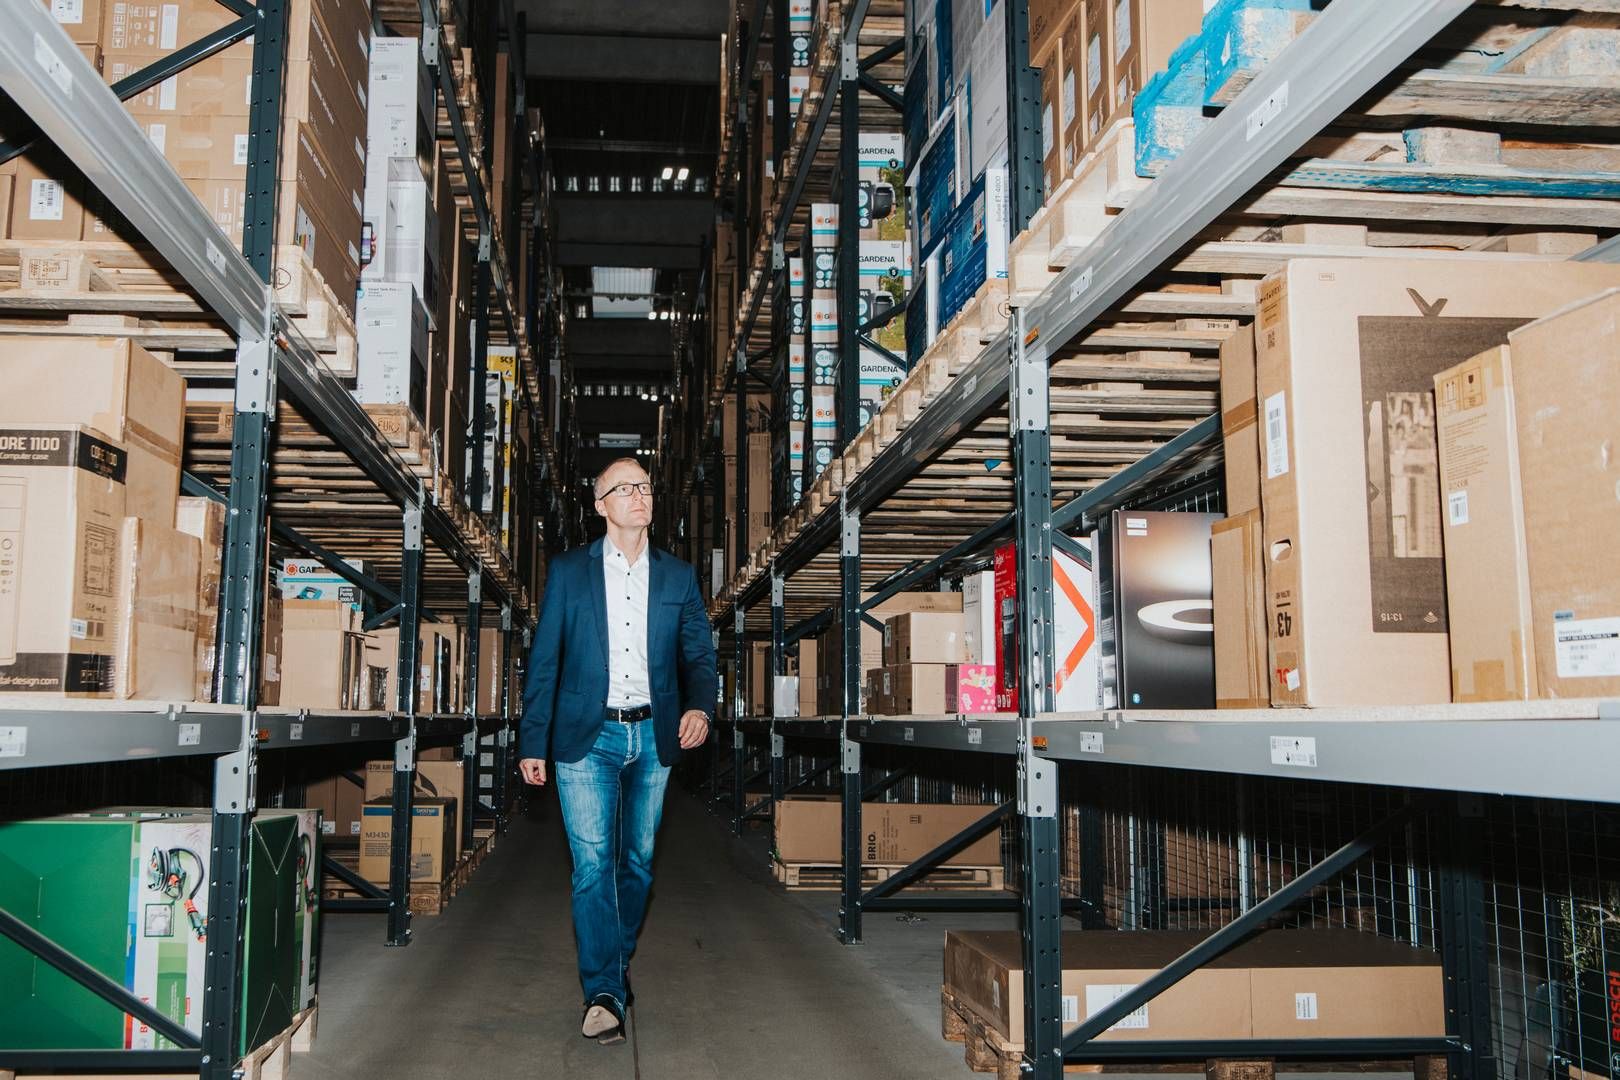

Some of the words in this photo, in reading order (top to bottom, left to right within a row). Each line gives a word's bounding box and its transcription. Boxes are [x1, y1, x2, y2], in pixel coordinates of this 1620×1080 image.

[858, 147, 896, 155] GARDENA
[858, 255, 896, 263] GARDENA
[860, 365, 898, 373] GARDENA
[30, 437, 60, 451] 1100
[1381, 612, 1403, 622] 13:15
